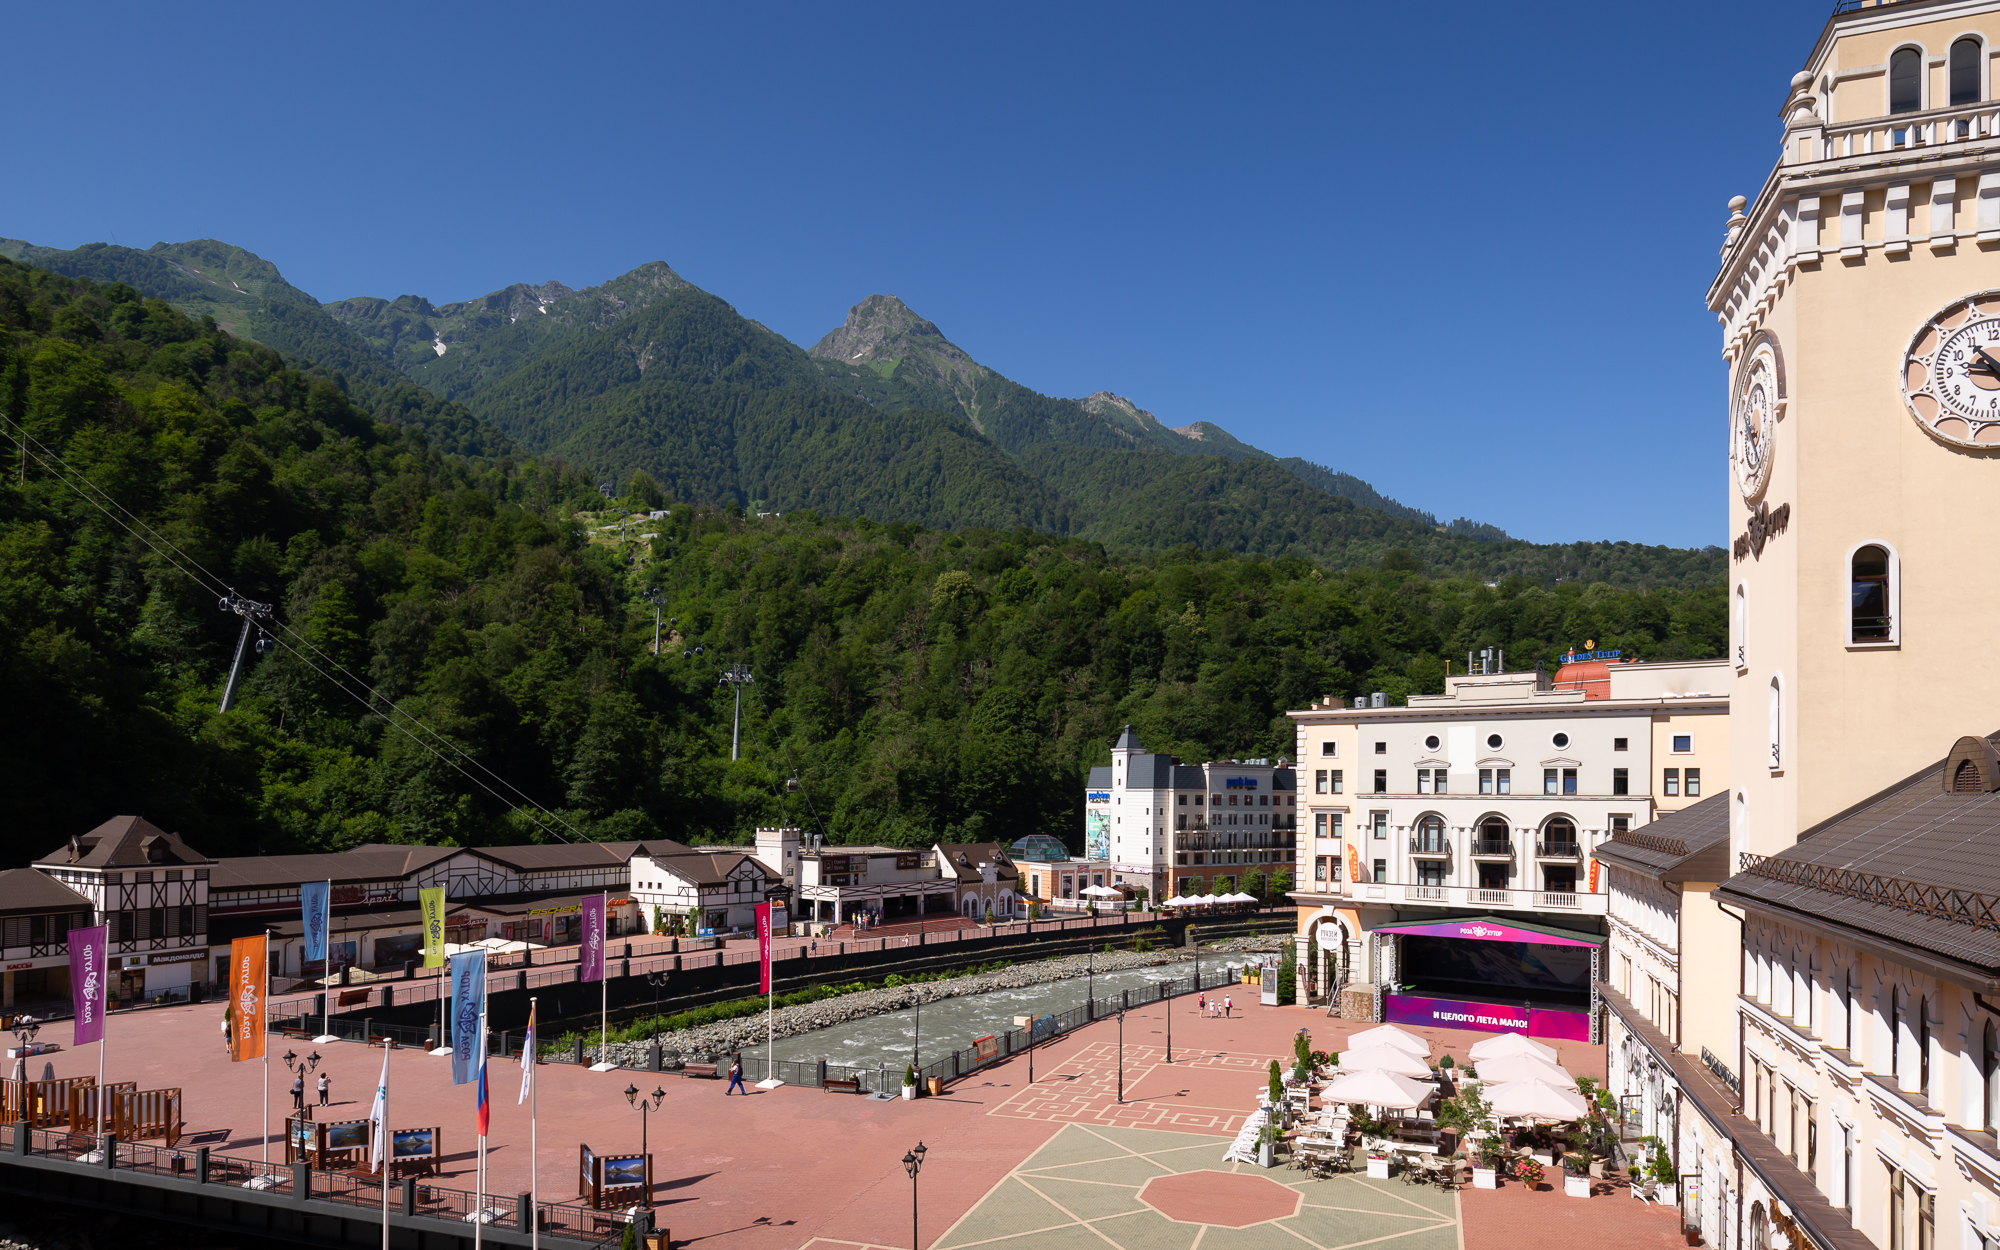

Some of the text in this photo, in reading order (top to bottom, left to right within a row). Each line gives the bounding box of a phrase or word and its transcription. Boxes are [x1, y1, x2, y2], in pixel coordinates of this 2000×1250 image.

[1988, 329, 1999, 341] 12
[1967, 336, 1976, 348] 11
[1953, 350, 1964, 361] 10
[1946, 367, 1953, 378] 9
[1954, 384, 1961, 395] 8
[1969, 395, 1976, 405] 7
[1990, 397, 1997, 409] 6
[1560, 650, 1621, 662] GOLDEN TULIP
[529, 905, 577, 916] FISCHER
[1459, 927, 1473, 935] РОЗА
[1575, 946, 1591, 954] ХУТО
[153, 952, 205, 964] Макдоналдс
[6, 962, 33, 970] КАССЫ
[1433, 1011, 1528, 1029] И ЦЕЛОГО ЛЕТА МАЛО!
